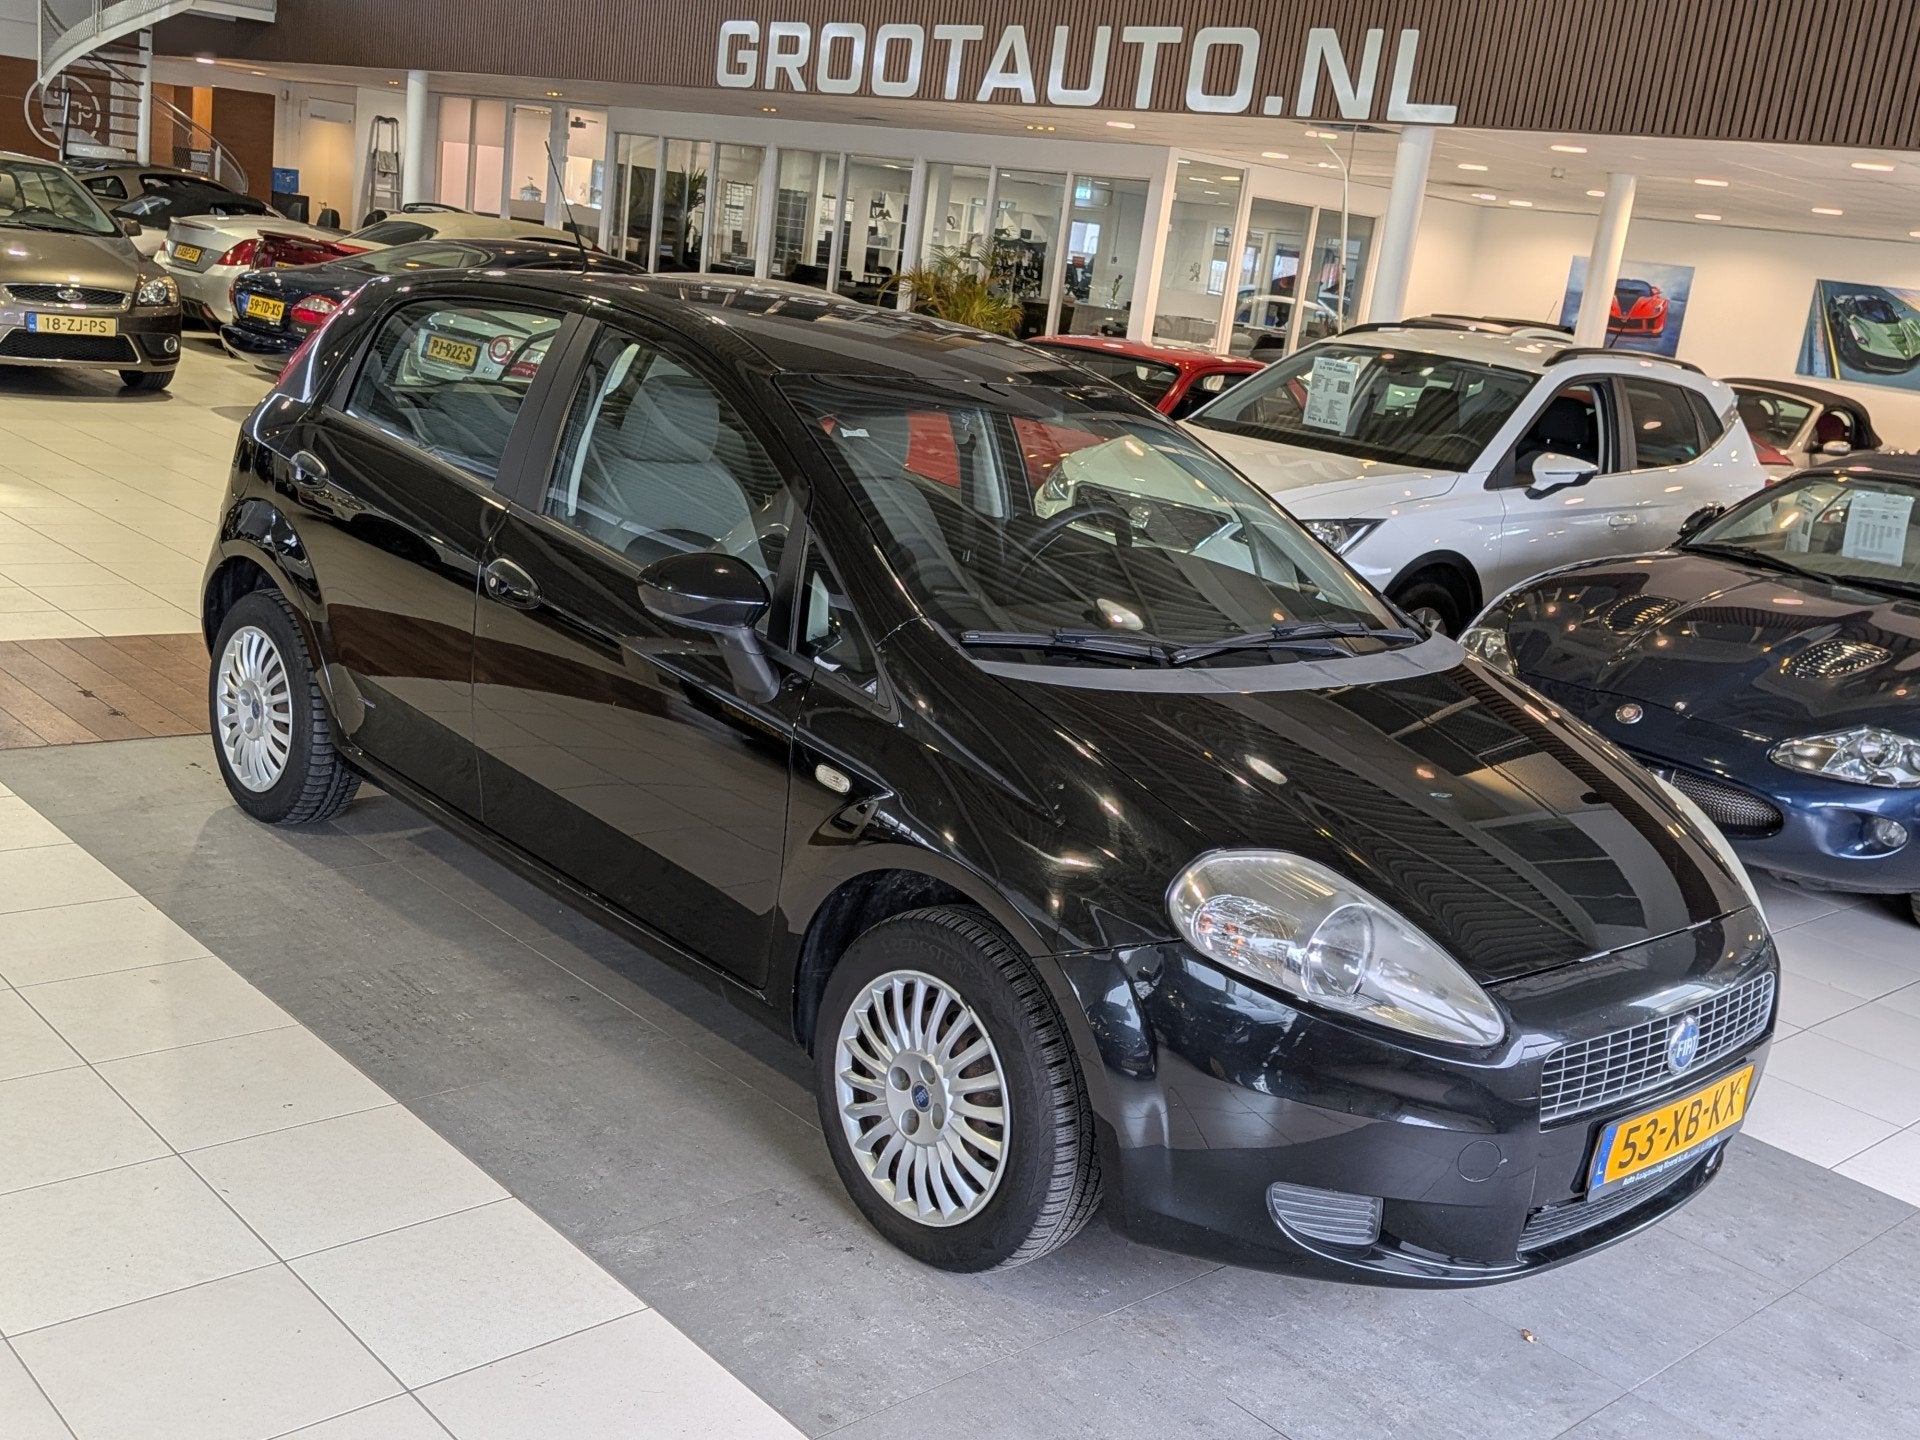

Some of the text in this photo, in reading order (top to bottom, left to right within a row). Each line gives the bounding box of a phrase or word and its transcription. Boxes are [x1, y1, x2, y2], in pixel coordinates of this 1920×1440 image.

[716, 19, 1458, 125] GROOTAUTO.NL
[249, 297, 282, 317] 59-TD-XS
[45, 317, 107, 333] 18-ZJ-PS
[430, 339, 473, 363] PJ-922-S
[1676, 1034, 1698, 1059] FIAT
[1617, 1077, 1743, 1169] 53-XB-KX
